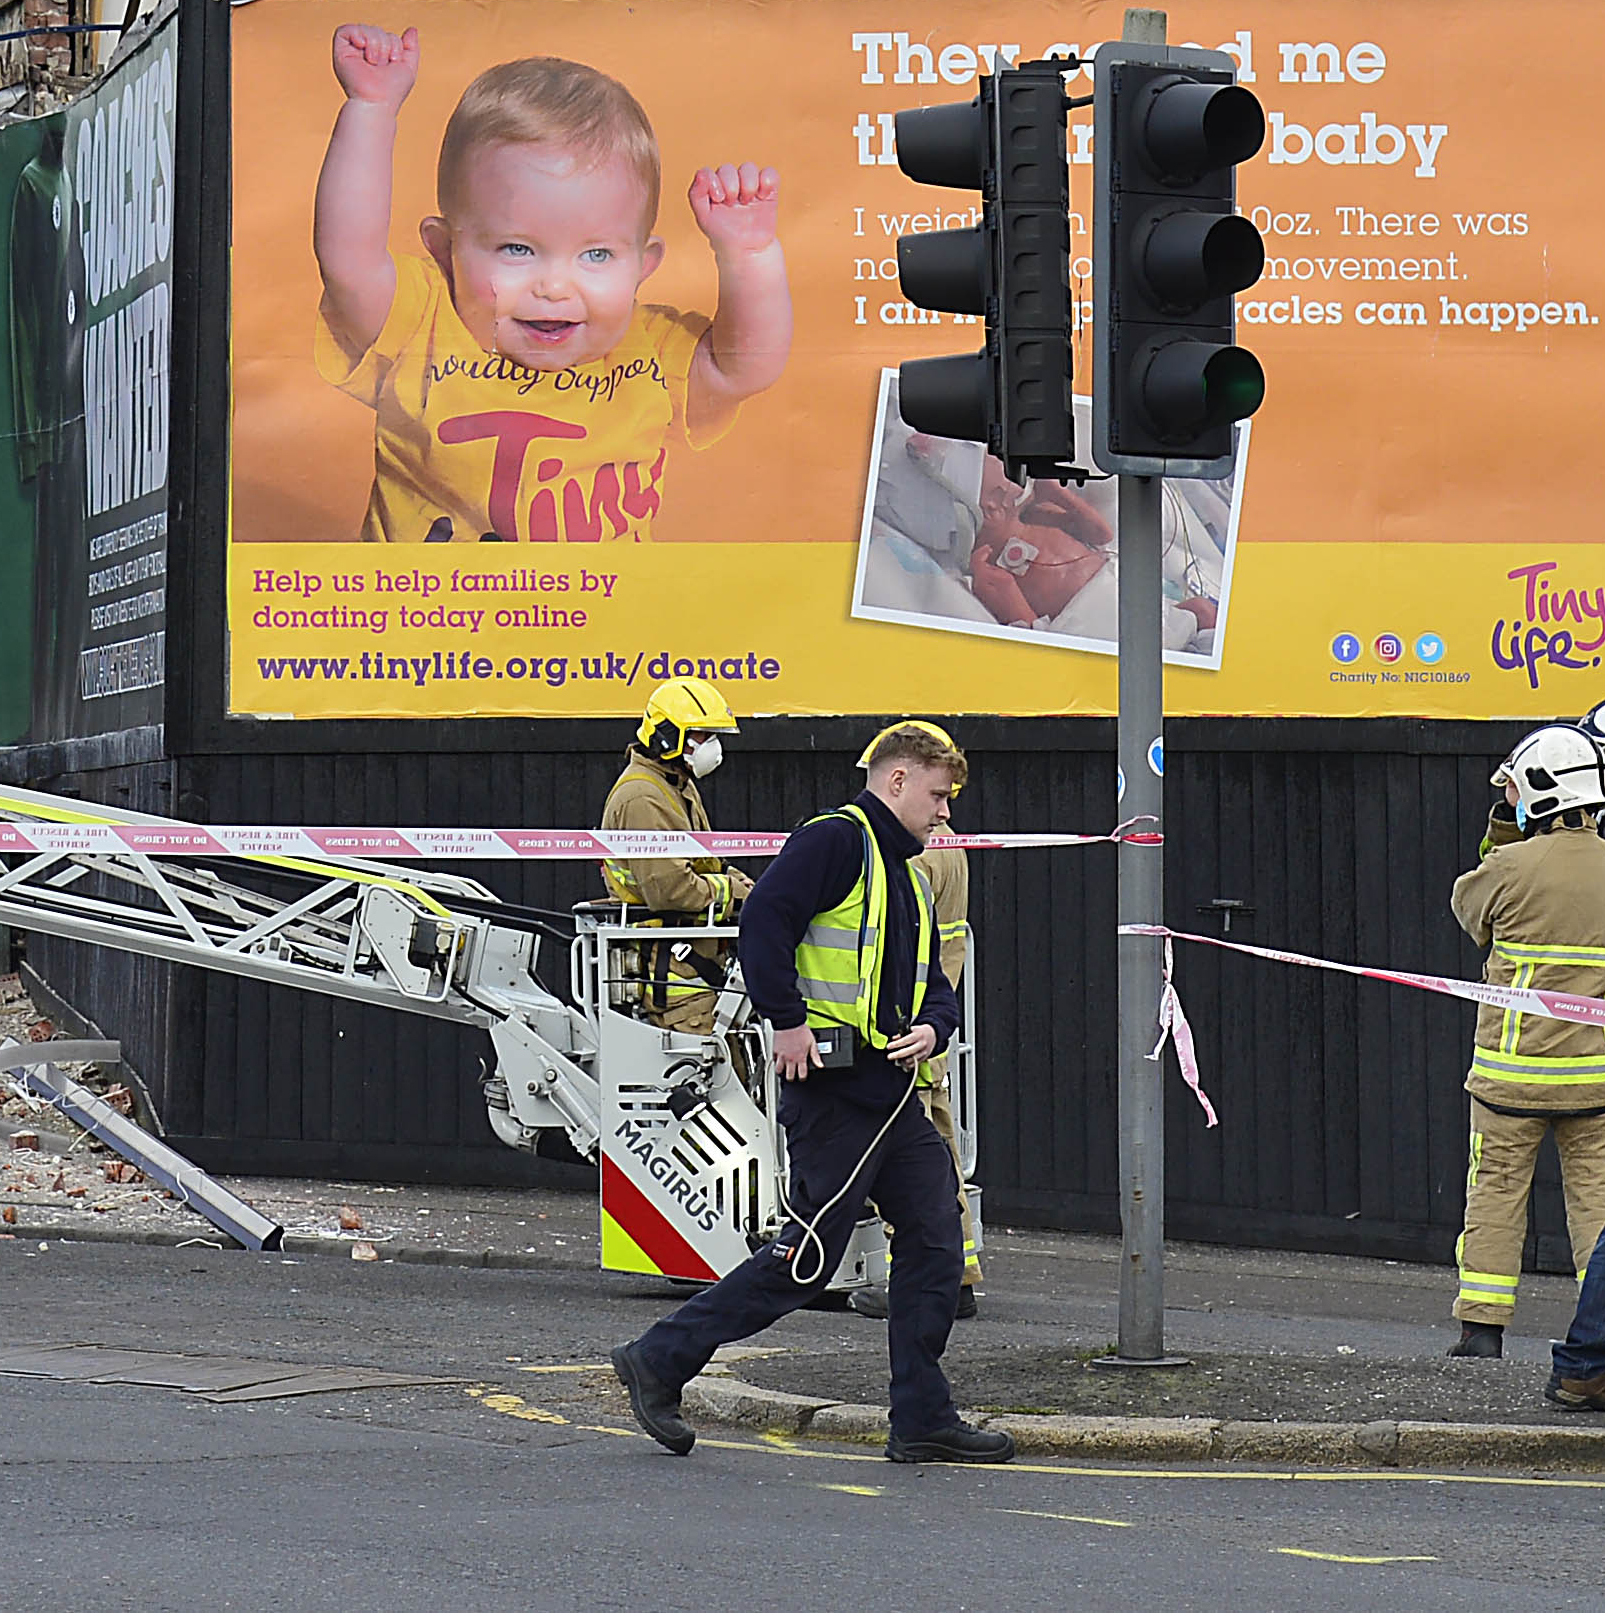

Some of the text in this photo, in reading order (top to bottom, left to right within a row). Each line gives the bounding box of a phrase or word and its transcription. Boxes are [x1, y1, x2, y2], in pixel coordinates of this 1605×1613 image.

[1278, 41, 1387, 84] me
[1268, 112, 1448, 178] baby
[76, 47, 172, 306] COACHES
[853, 207, 865, 236] I
[1335, 206, 1440, 236] There
[1452, 212, 1529, 236] was
[1262, 251, 1469, 281] movement.
[854, 296, 867, 324] I
[1354, 301, 1428, 325] can
[1438, 295, 1600, 332] happen.
[83, 282, 170, 520] WANTED
[253, 569, 618, 598] Help us help families by
[253, 604, 588, 634] donating today online
[257, 651, 781, 687] www.tinylife.org.uk/donate
[1329, 671, 1471, 685] Charity No: NIC101869
[614, 1119, 720, 1232] MAGIRUS
